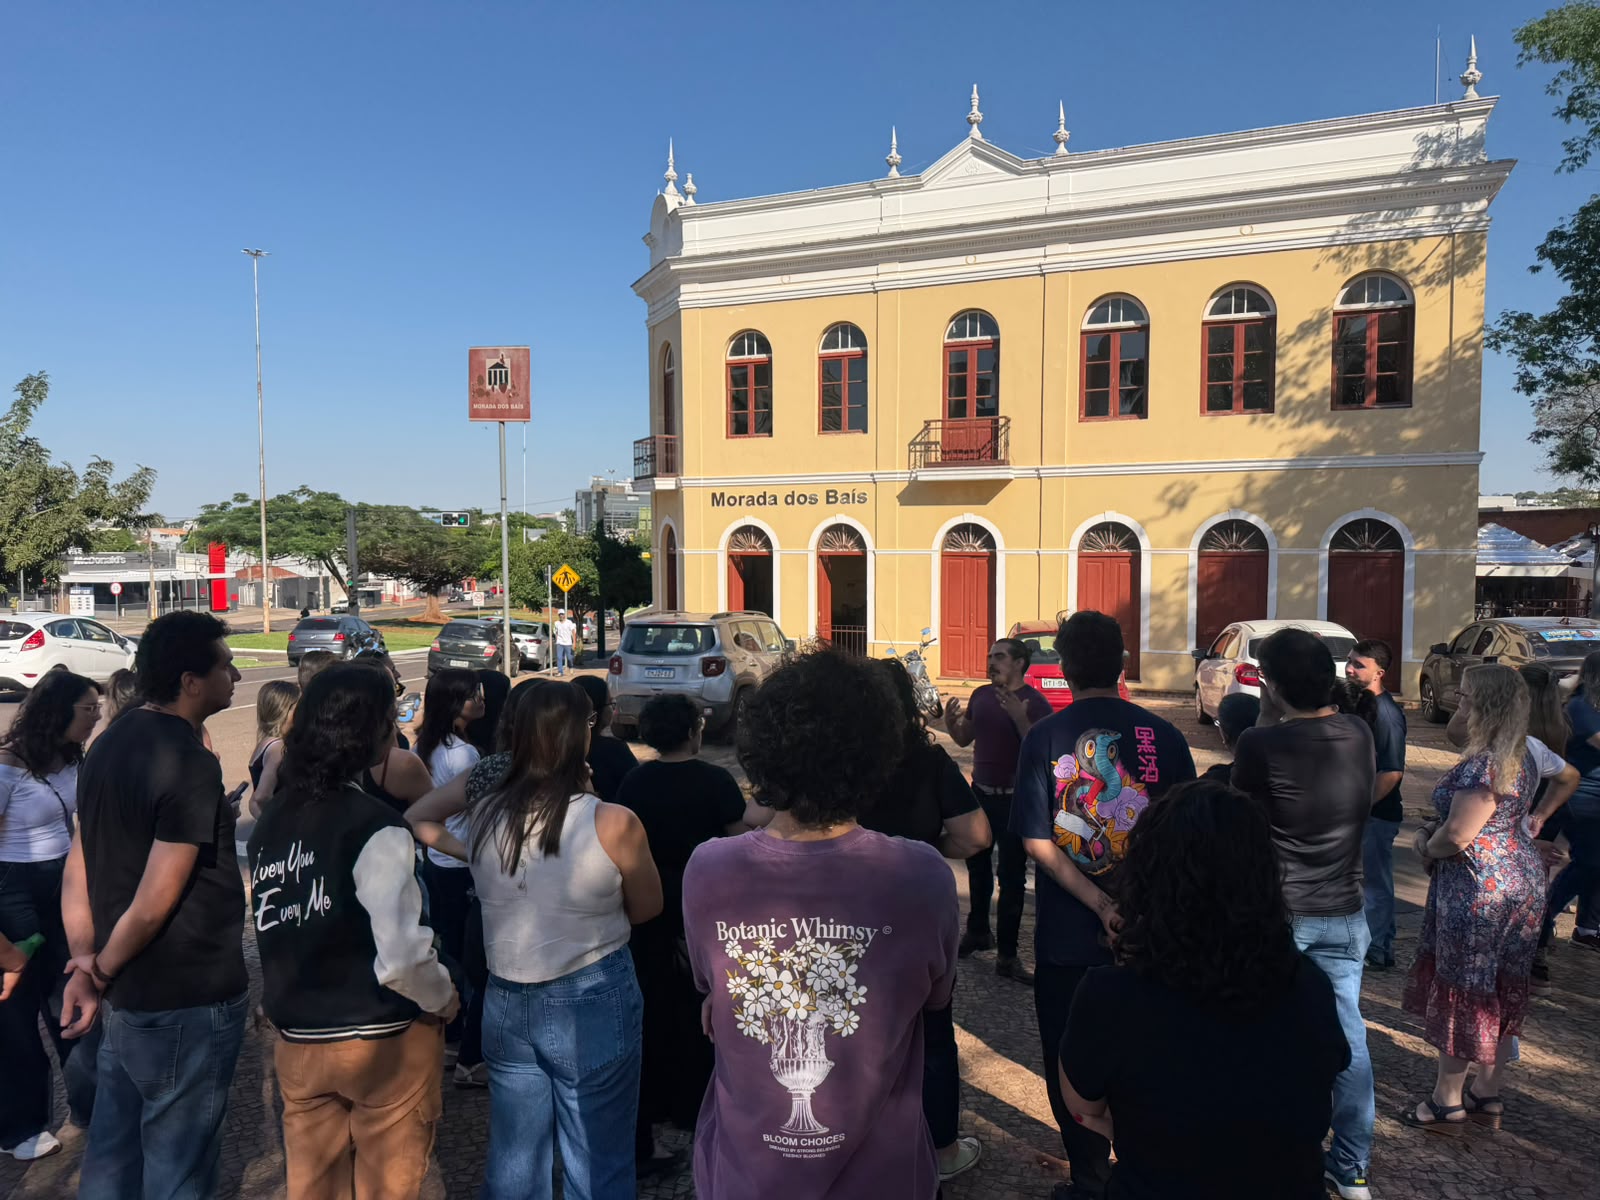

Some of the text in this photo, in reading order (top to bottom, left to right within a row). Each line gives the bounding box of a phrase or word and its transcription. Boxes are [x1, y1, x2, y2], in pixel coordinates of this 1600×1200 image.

[711, 487, 868, 507] Morada dos Baís
[73, 555, 127, 565] McDonald's
[287, 839, 316, 884] You
[254, 875, 332, 932] Every Me
[715, 918, 788, 941] Botanic
[789, 916, 879, 947] Whimsy
[762, 1132, 846, 1147] BLOOM CHOICES
